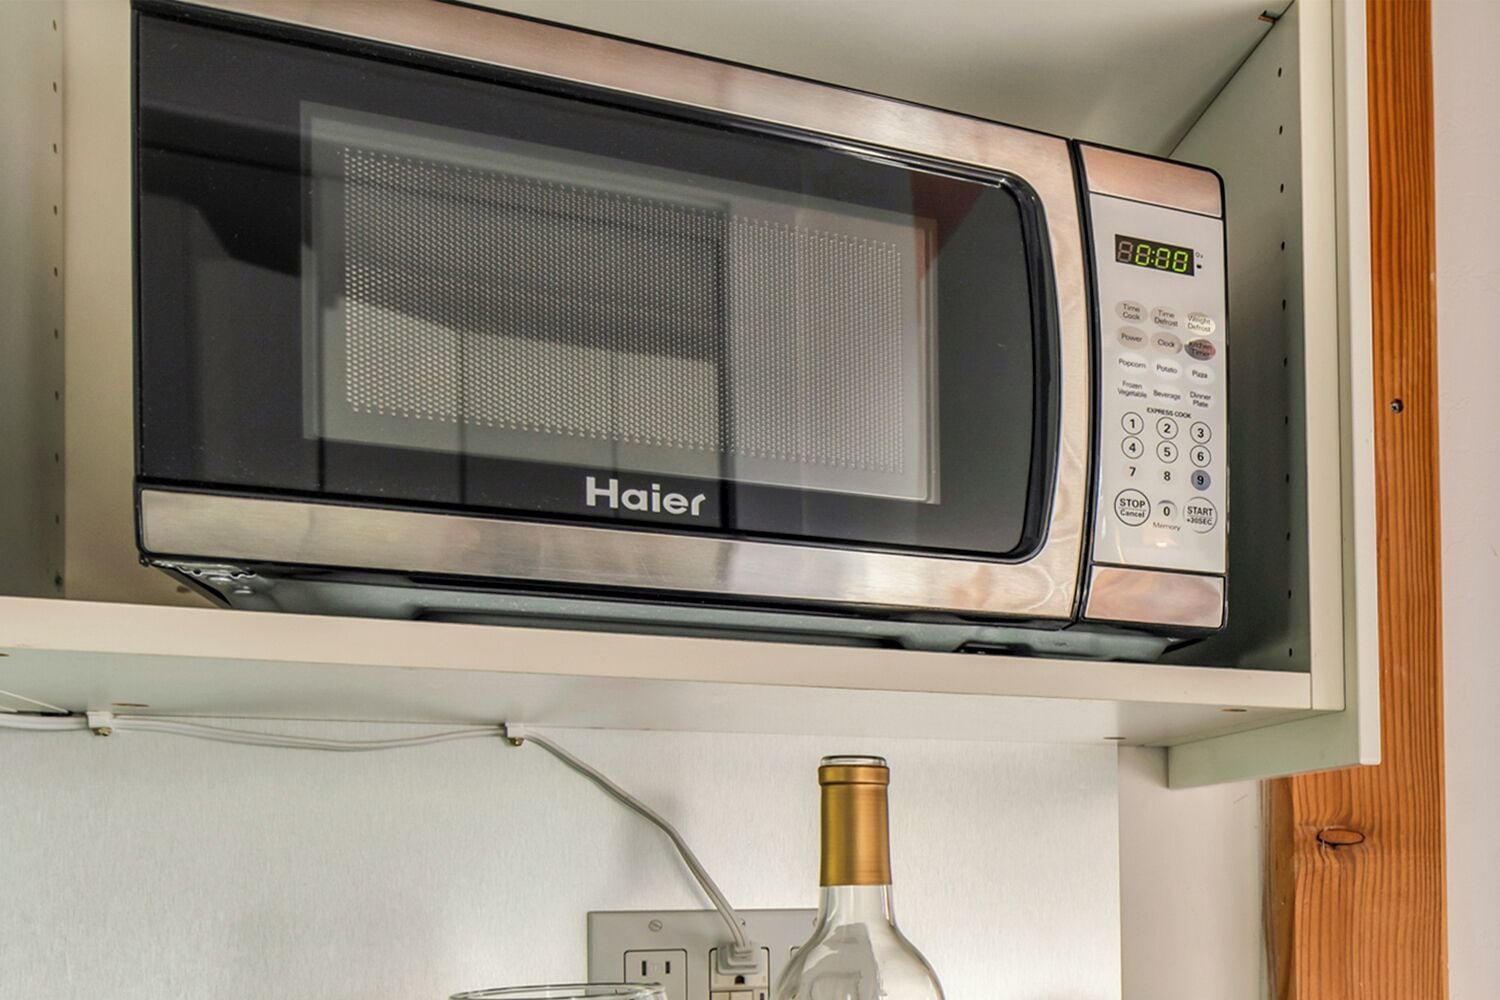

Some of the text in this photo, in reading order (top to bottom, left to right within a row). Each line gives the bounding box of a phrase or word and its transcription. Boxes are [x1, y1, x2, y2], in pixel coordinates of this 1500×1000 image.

[1123, 303, 1140, 313] Time
[1123, 311, 1140, 320] Cook
[1158, 310, 1175, 319] Time
[1154, 317, 1178, 327] Defrost
[1187, 322, 1211, 332] Defrost
[1121, 333, 1142, 343] Power
[1157, 338, 1175, 348] Clock
[1118, 358, 1146, 369] Popcorn
[1156, 364, 1178, 374] Potato
[1192, 370, 1208, 379] Pizza
[1122, 380, 1142, 389] Frozen
[1117, 388, 1147, 398] Vegetable
[1153, 390, 1181, 400] Beverage
[1189, 391, 1211, 400] Dinner
[1192, 400, 1209, 408] Plate
[1146, 407, 1191, 419] EXPRESS COOK
[1129, 419, 1135, 428] 1
[1163, 423, 1171, 434] 2
[1197, 428, 1204, 438] 3
[1129, 443, 1136, 452] 4
[1164, 447, 1171, 457] 5
[1197, 452, 1204, 461] 6
[1129, 466, 1136, 477] 7
[1163, 471, 1171, 481] 8
[1197, 475, 1204, 485] 9
[586, 476, 706, 516] Haier
[1119, 498, 1146, 508] STOP
[1120, 509, 1145, 518] Cancel
[1163, 506, 1170, 517] 0
[1187, 506, 1213, 516] START
[1152, 522, 1181, 531] Memory
